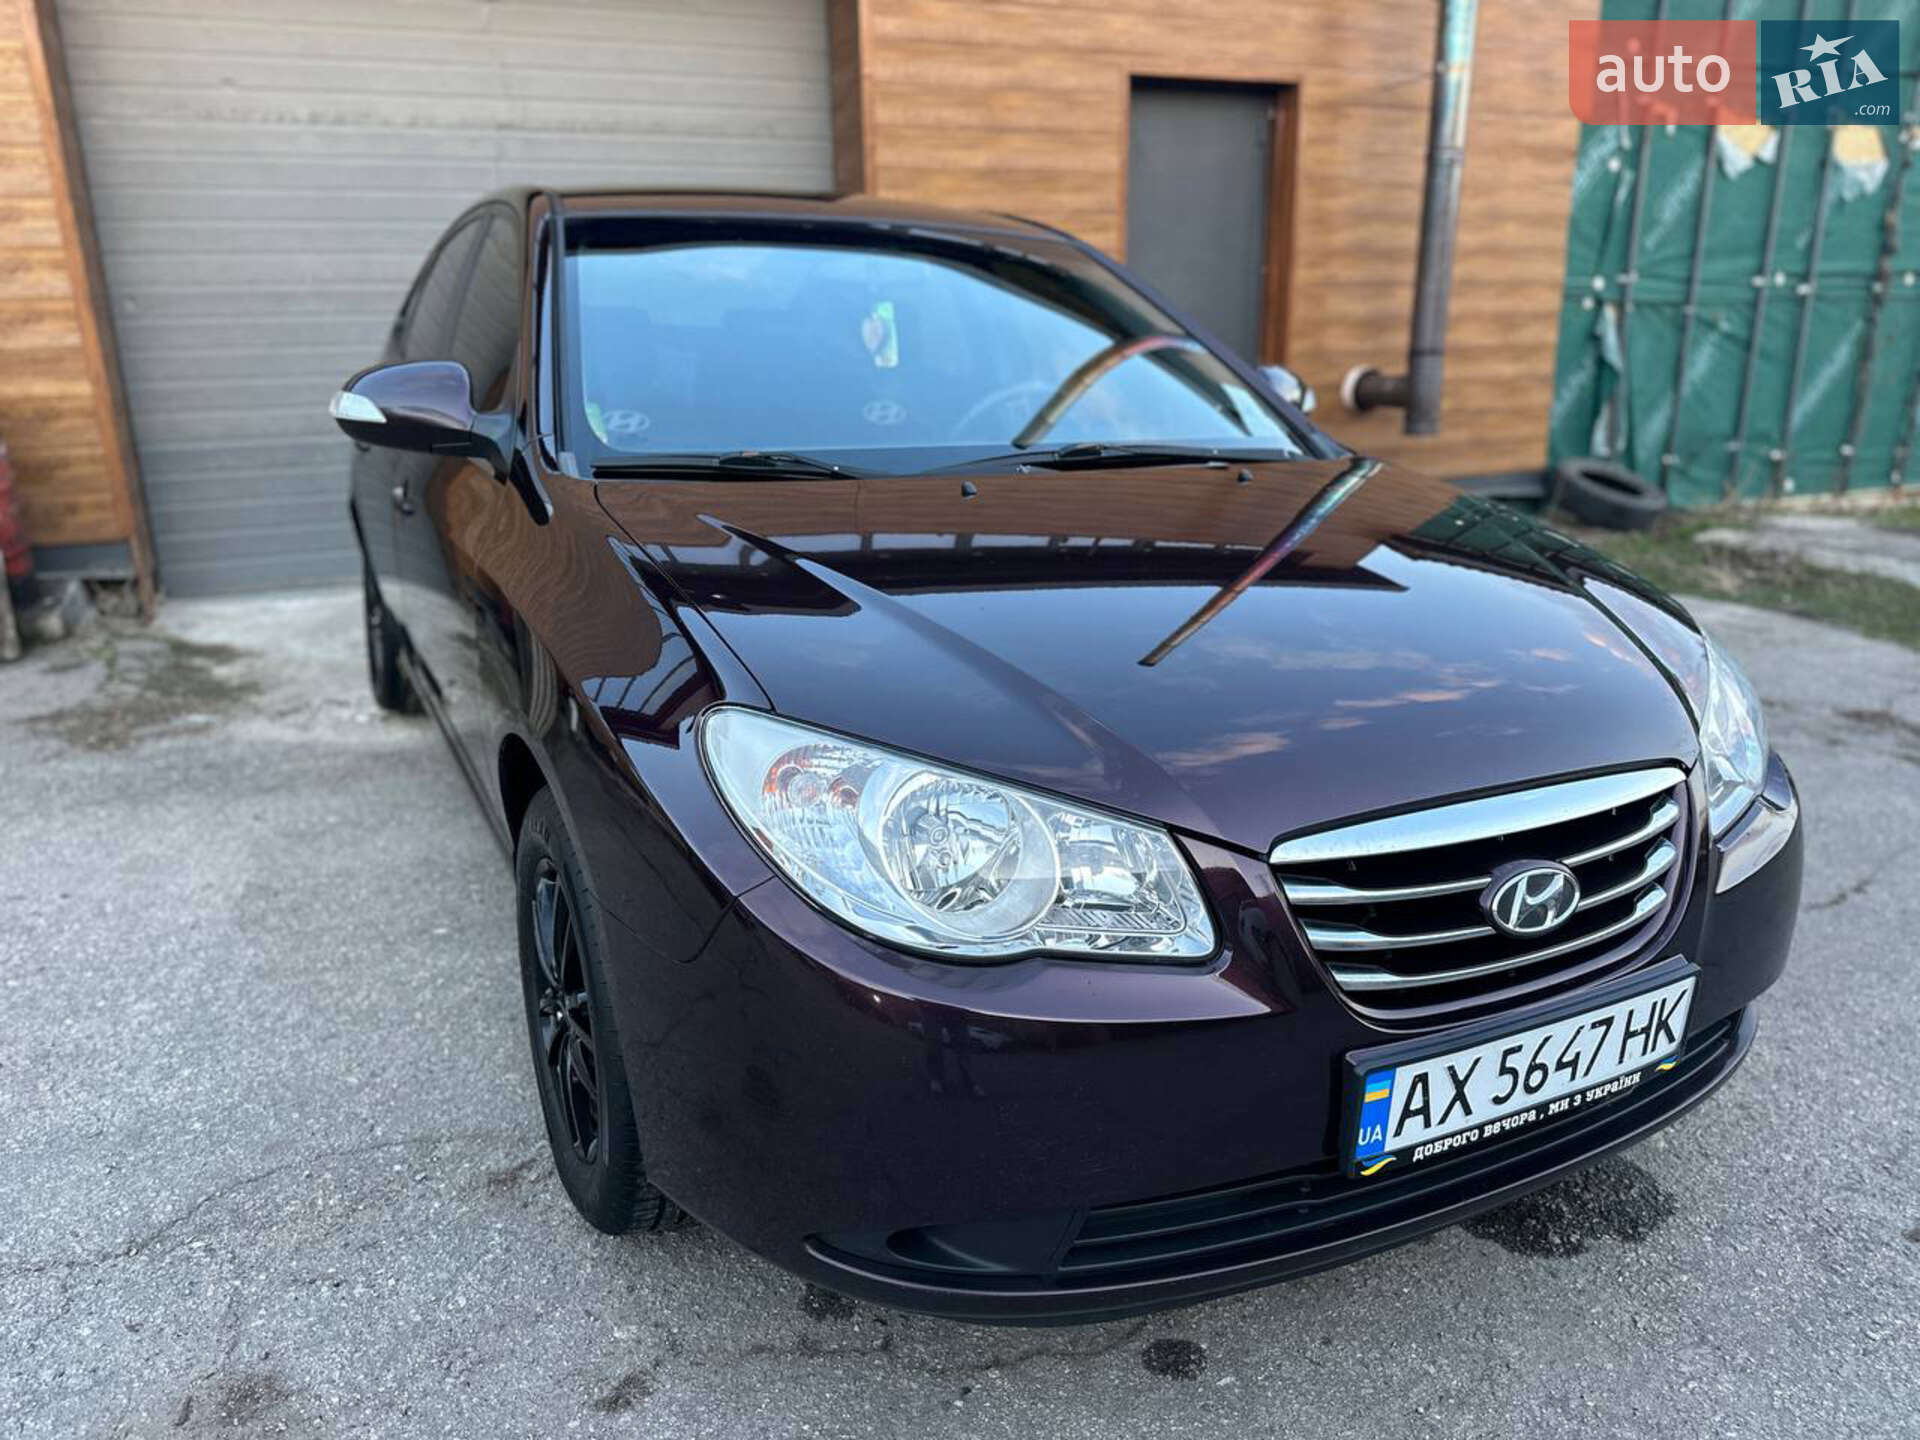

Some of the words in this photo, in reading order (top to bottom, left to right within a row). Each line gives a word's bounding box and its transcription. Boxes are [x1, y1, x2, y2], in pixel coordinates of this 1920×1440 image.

[1393, 1055, 1482, 1138] AX
[1492, 1016, 1615, 1106] 5647
[1617, 988, 1688, 1065] HK
[1358, 1123, 1383, 1145] UA
[1412, 1129, 1479, 1162] ДОБРОГО
